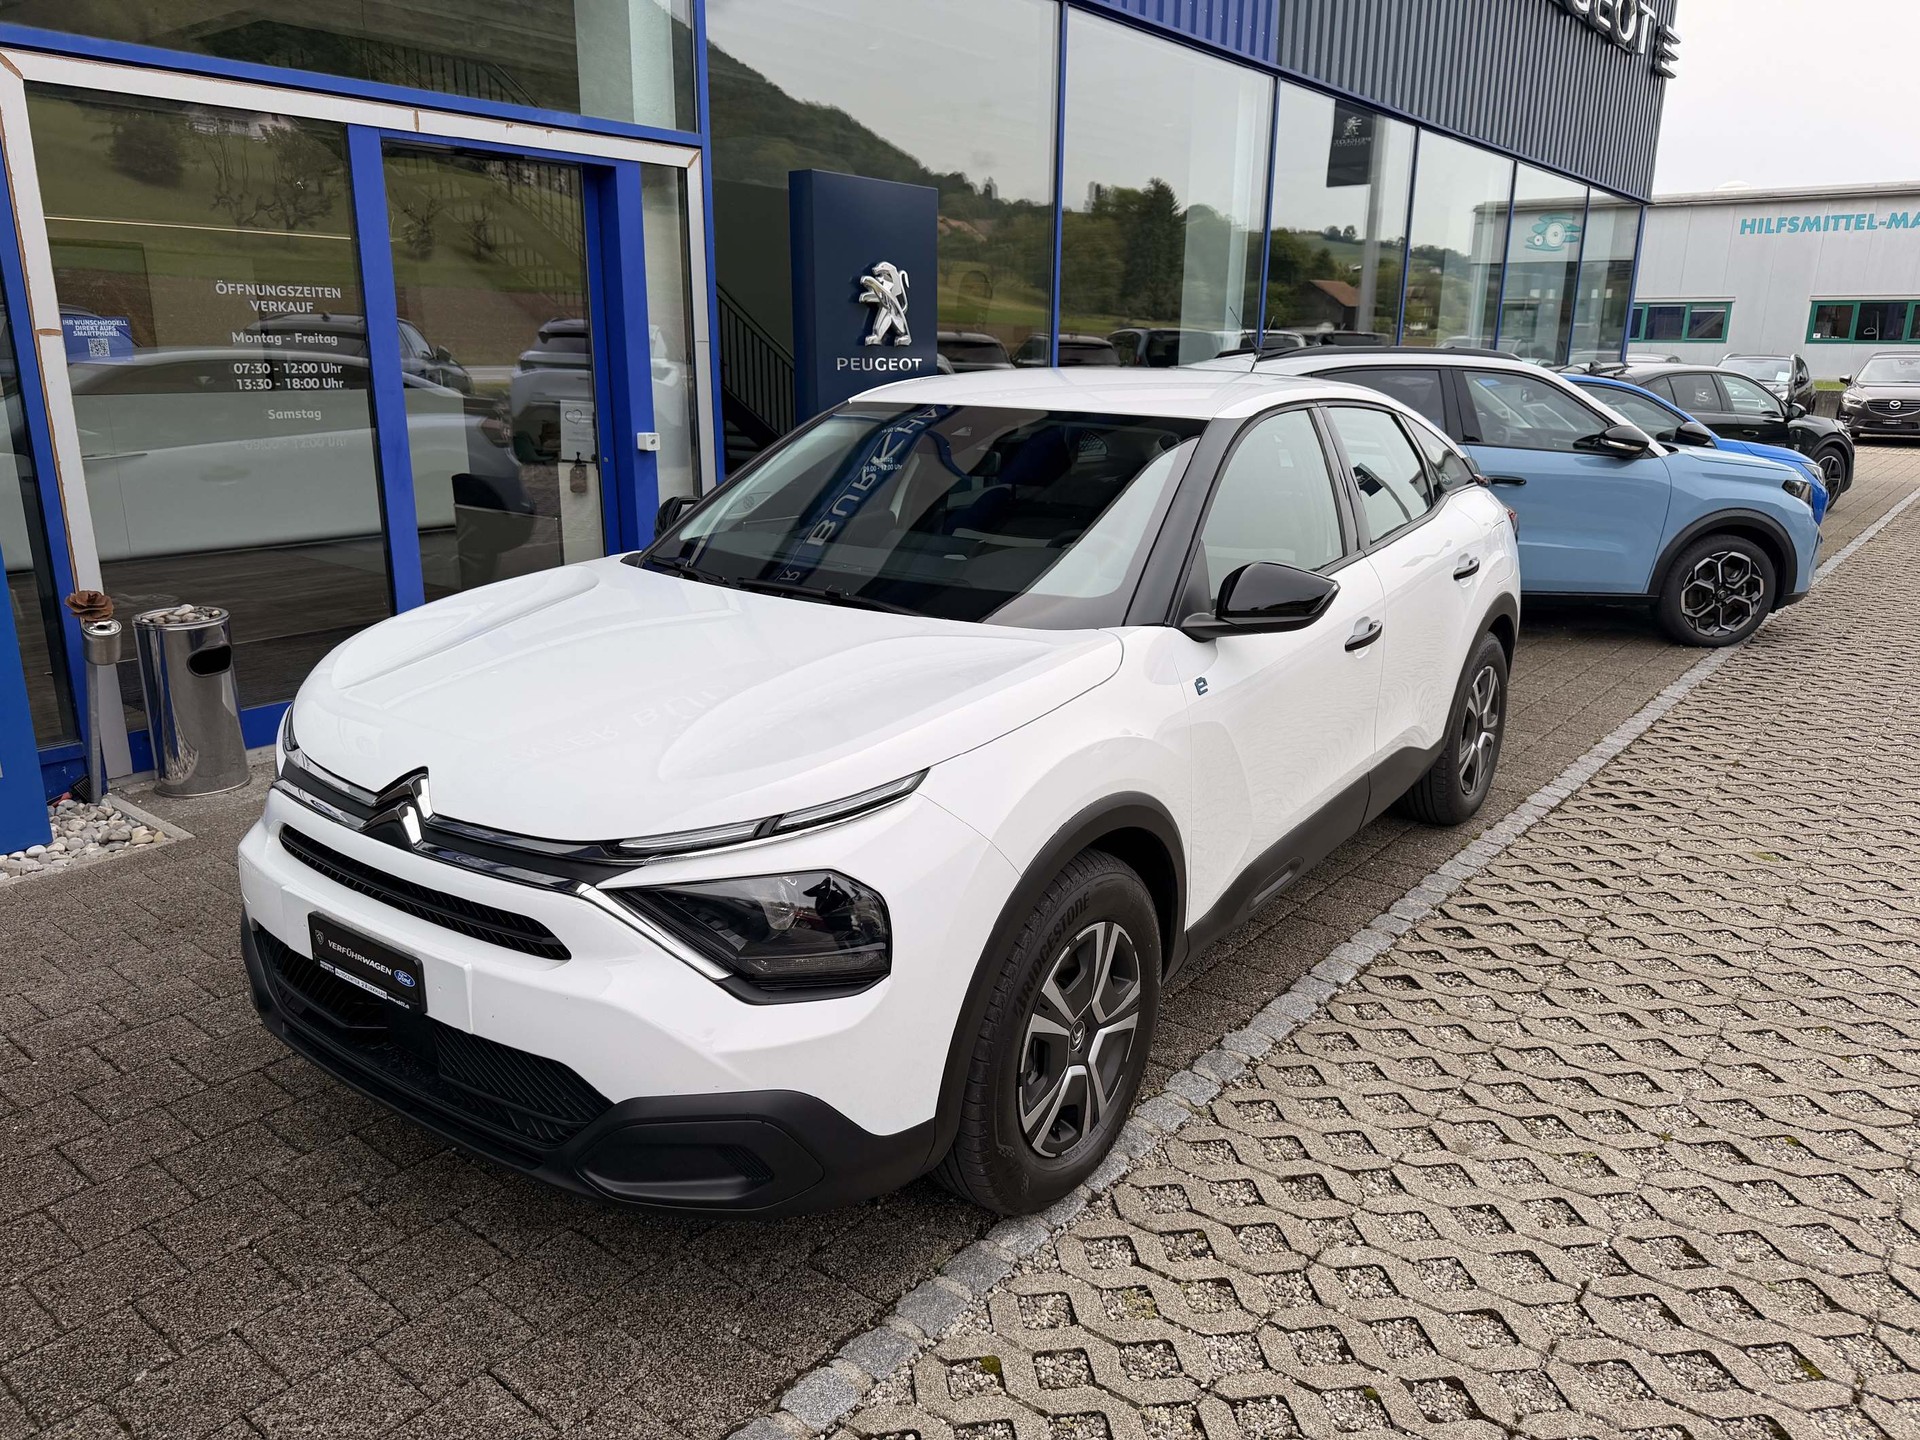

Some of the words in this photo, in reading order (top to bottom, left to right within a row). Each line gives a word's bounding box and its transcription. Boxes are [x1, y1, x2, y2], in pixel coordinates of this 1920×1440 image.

[215, 280, 341, 299] ÖFFNUNGSZEITEN
[250, 300, 314, 313] VERKAUF
[74, 319, 128, 327] WUNSCHMODELL
[232, 331, 281, 345] Montag
[295, 332, 338, 346] Freitag
[233, 363, 271, 375] 07:30
[283, 362, 319, 375] 12:00
[321, 362, 343, 374] Uhr
[836, 357, 922, 371] PEUGEOT
[236, 378, 272, 390] 13:30
[286, 378, 320, 390] 18:00
[322, 377, 344, 389] Uhr
[268, 408, 322, 421] Samstag
[328, 939, 392, 976] VERFÜHRWAGEN
[1014, 891, 1090, 1018] BRIDGESTONE
